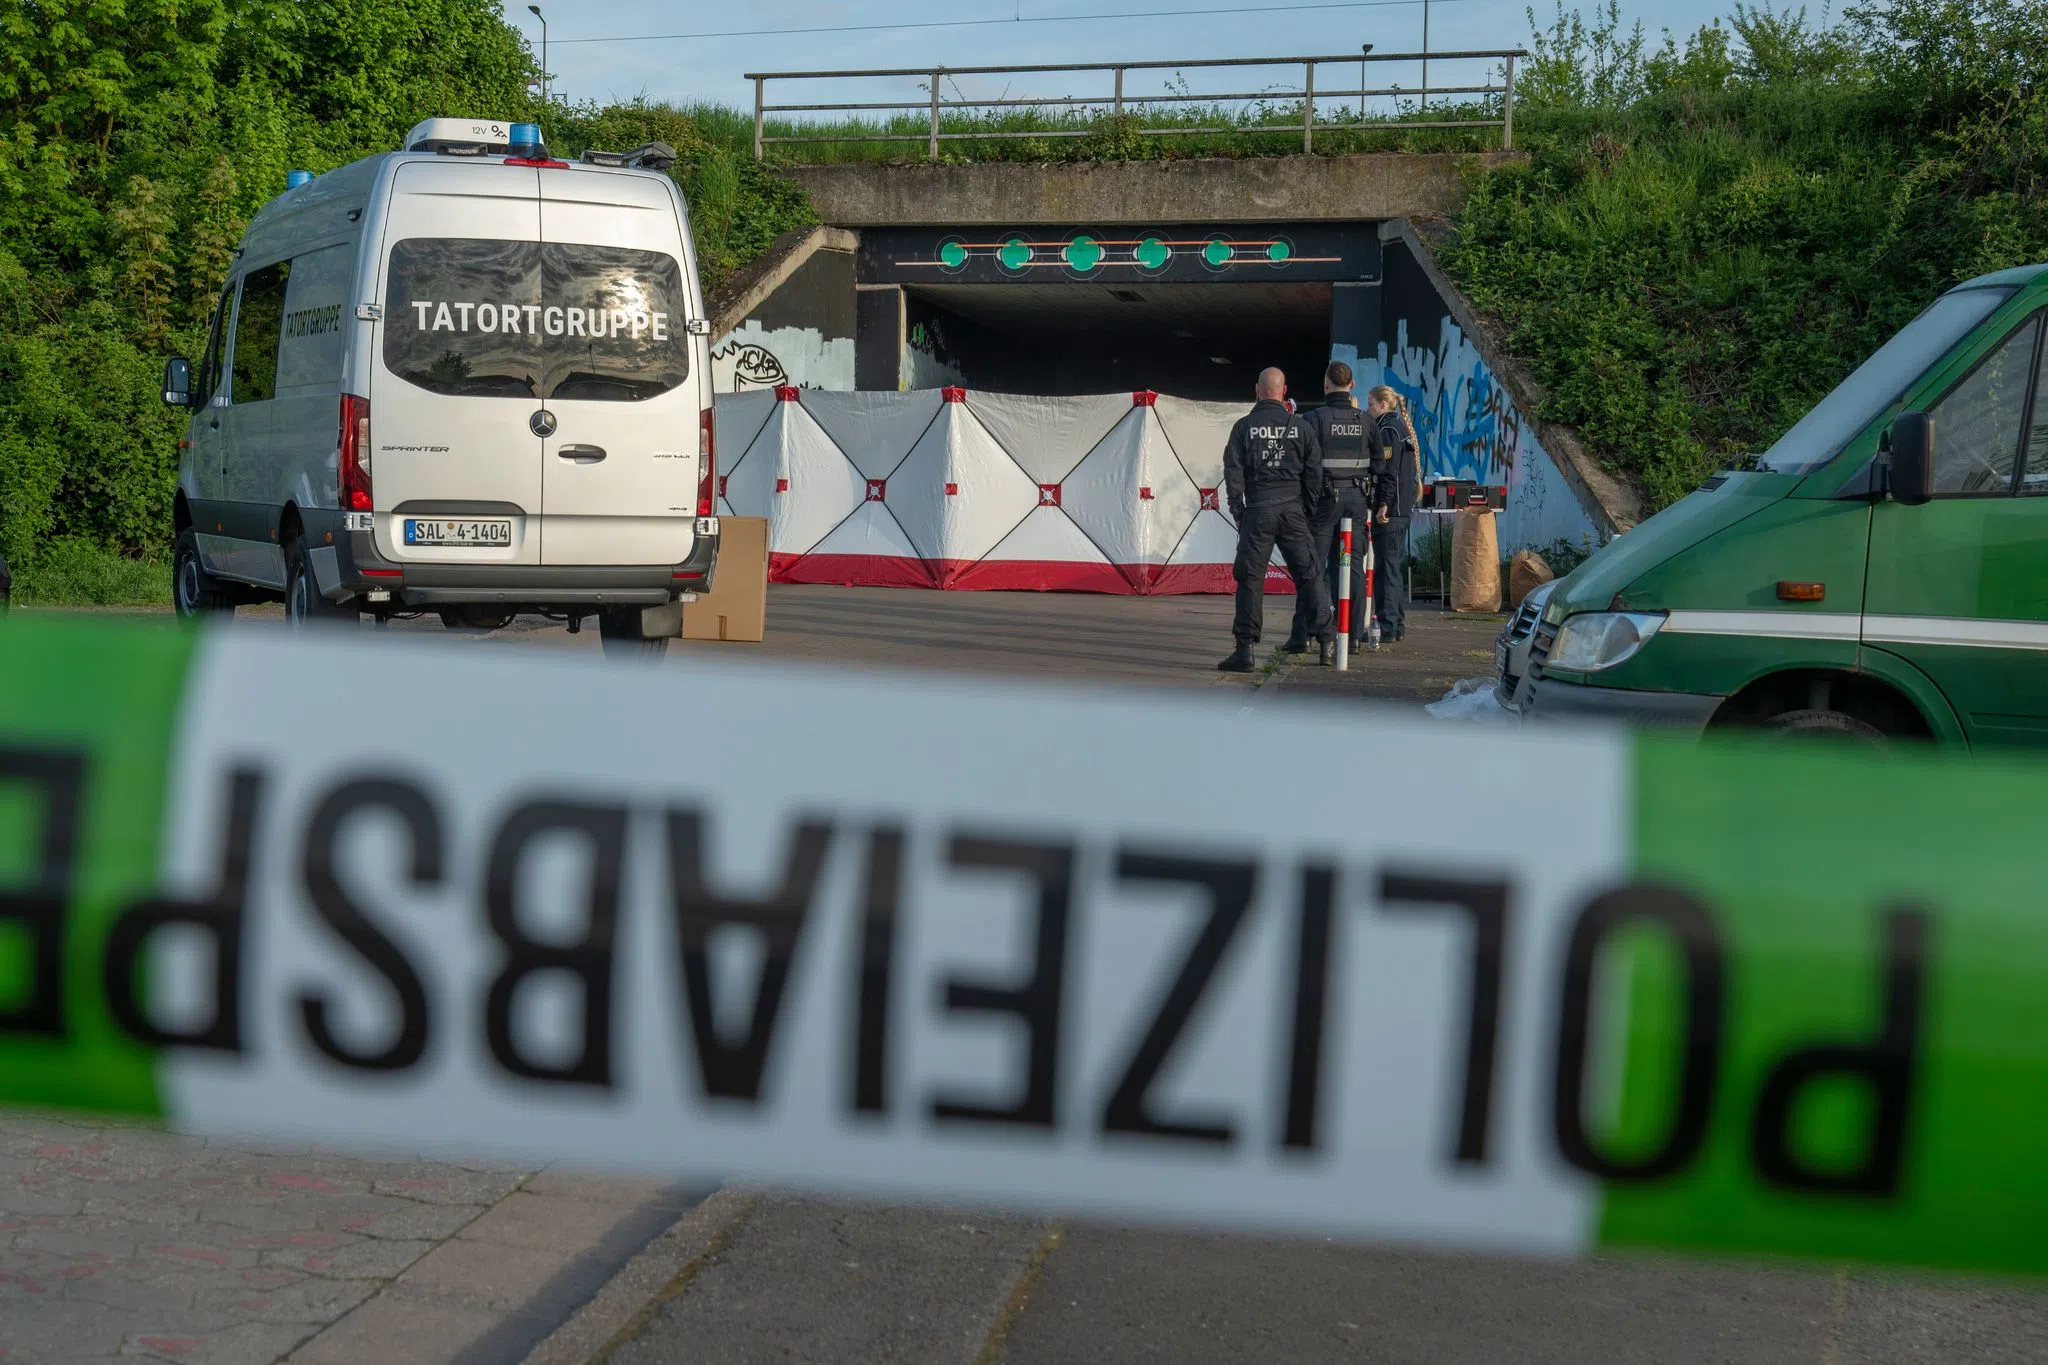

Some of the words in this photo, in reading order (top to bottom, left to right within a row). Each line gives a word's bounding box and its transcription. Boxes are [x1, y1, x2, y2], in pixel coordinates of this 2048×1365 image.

[472, 126, 487, 135] 12V
[286, 304, 341, 339] TATORTGRUPPE
[411, 301, 668, 341] TATORTGRUPPE
[1331, 425, 1362, 436] POLIZEI
[381, 445, 450, 453] SPRINTER
[416, 523, 445, 539] SAL
[457, 524, 508, 540] 4-1404
